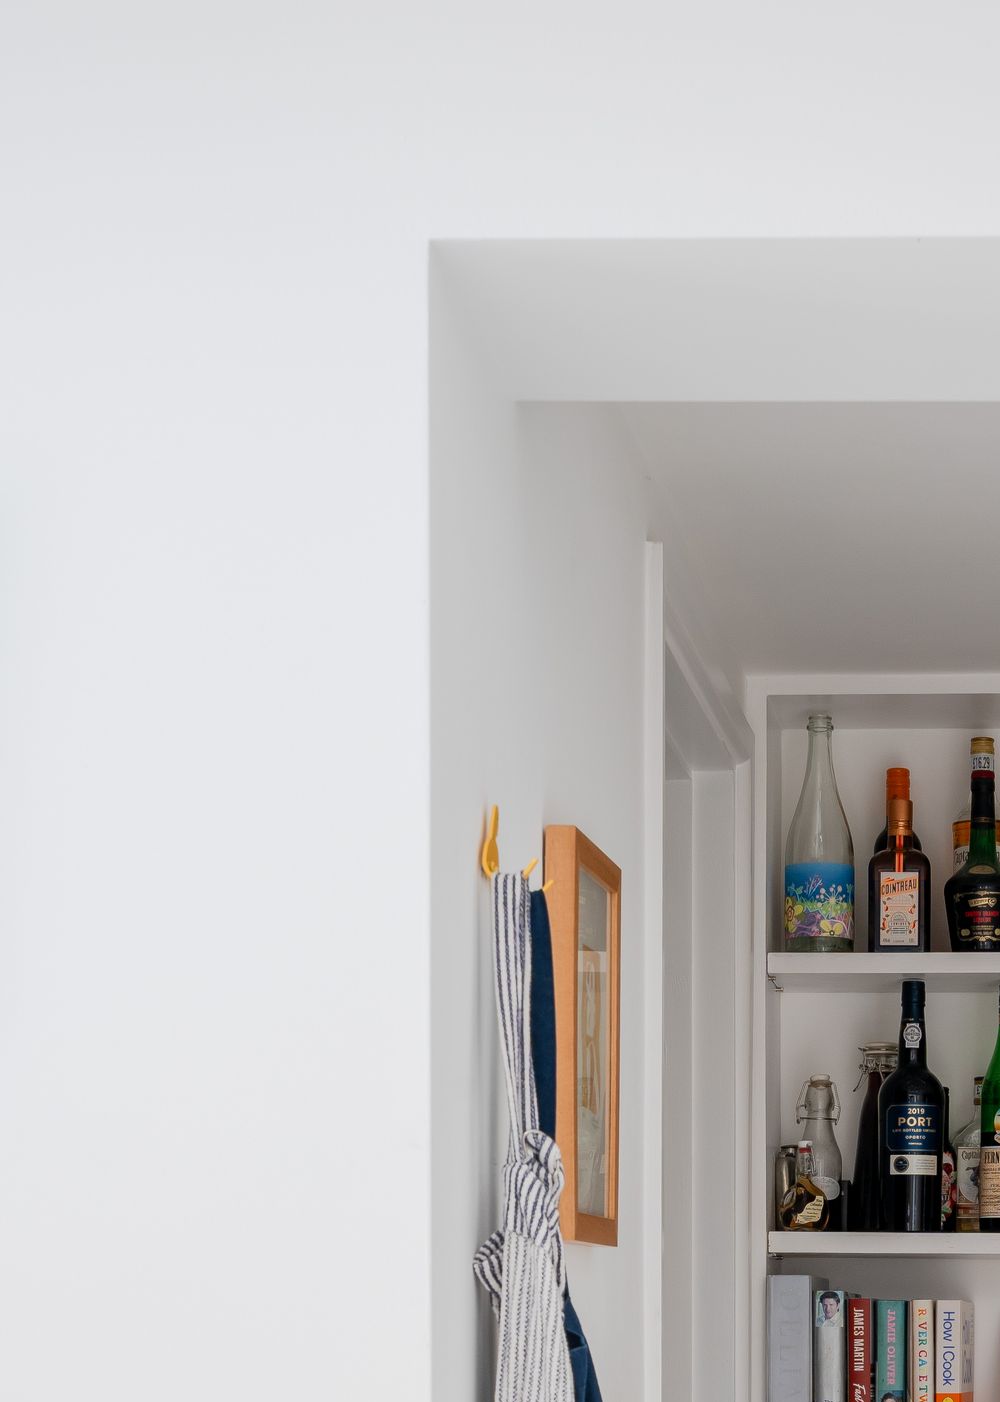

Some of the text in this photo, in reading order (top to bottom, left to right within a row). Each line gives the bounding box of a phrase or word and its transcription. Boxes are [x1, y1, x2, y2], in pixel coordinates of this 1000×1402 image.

[881, 879, 917, 895] COINTREAU
[898, 1116, 932, 1127] PORT
[907, 1107, 925, 1115] 2019
[853, 1307, 865, 1372] JAMES MARTIN
[917, 1308, 928, 1347] RVER
[942, 1311, 955, 1342] How
[886, 1308, 896, 1385] JAMIE OLIVER
[918, 1350, 928, 1382] CAE
[942, 1351, 955, 1386] Cook
